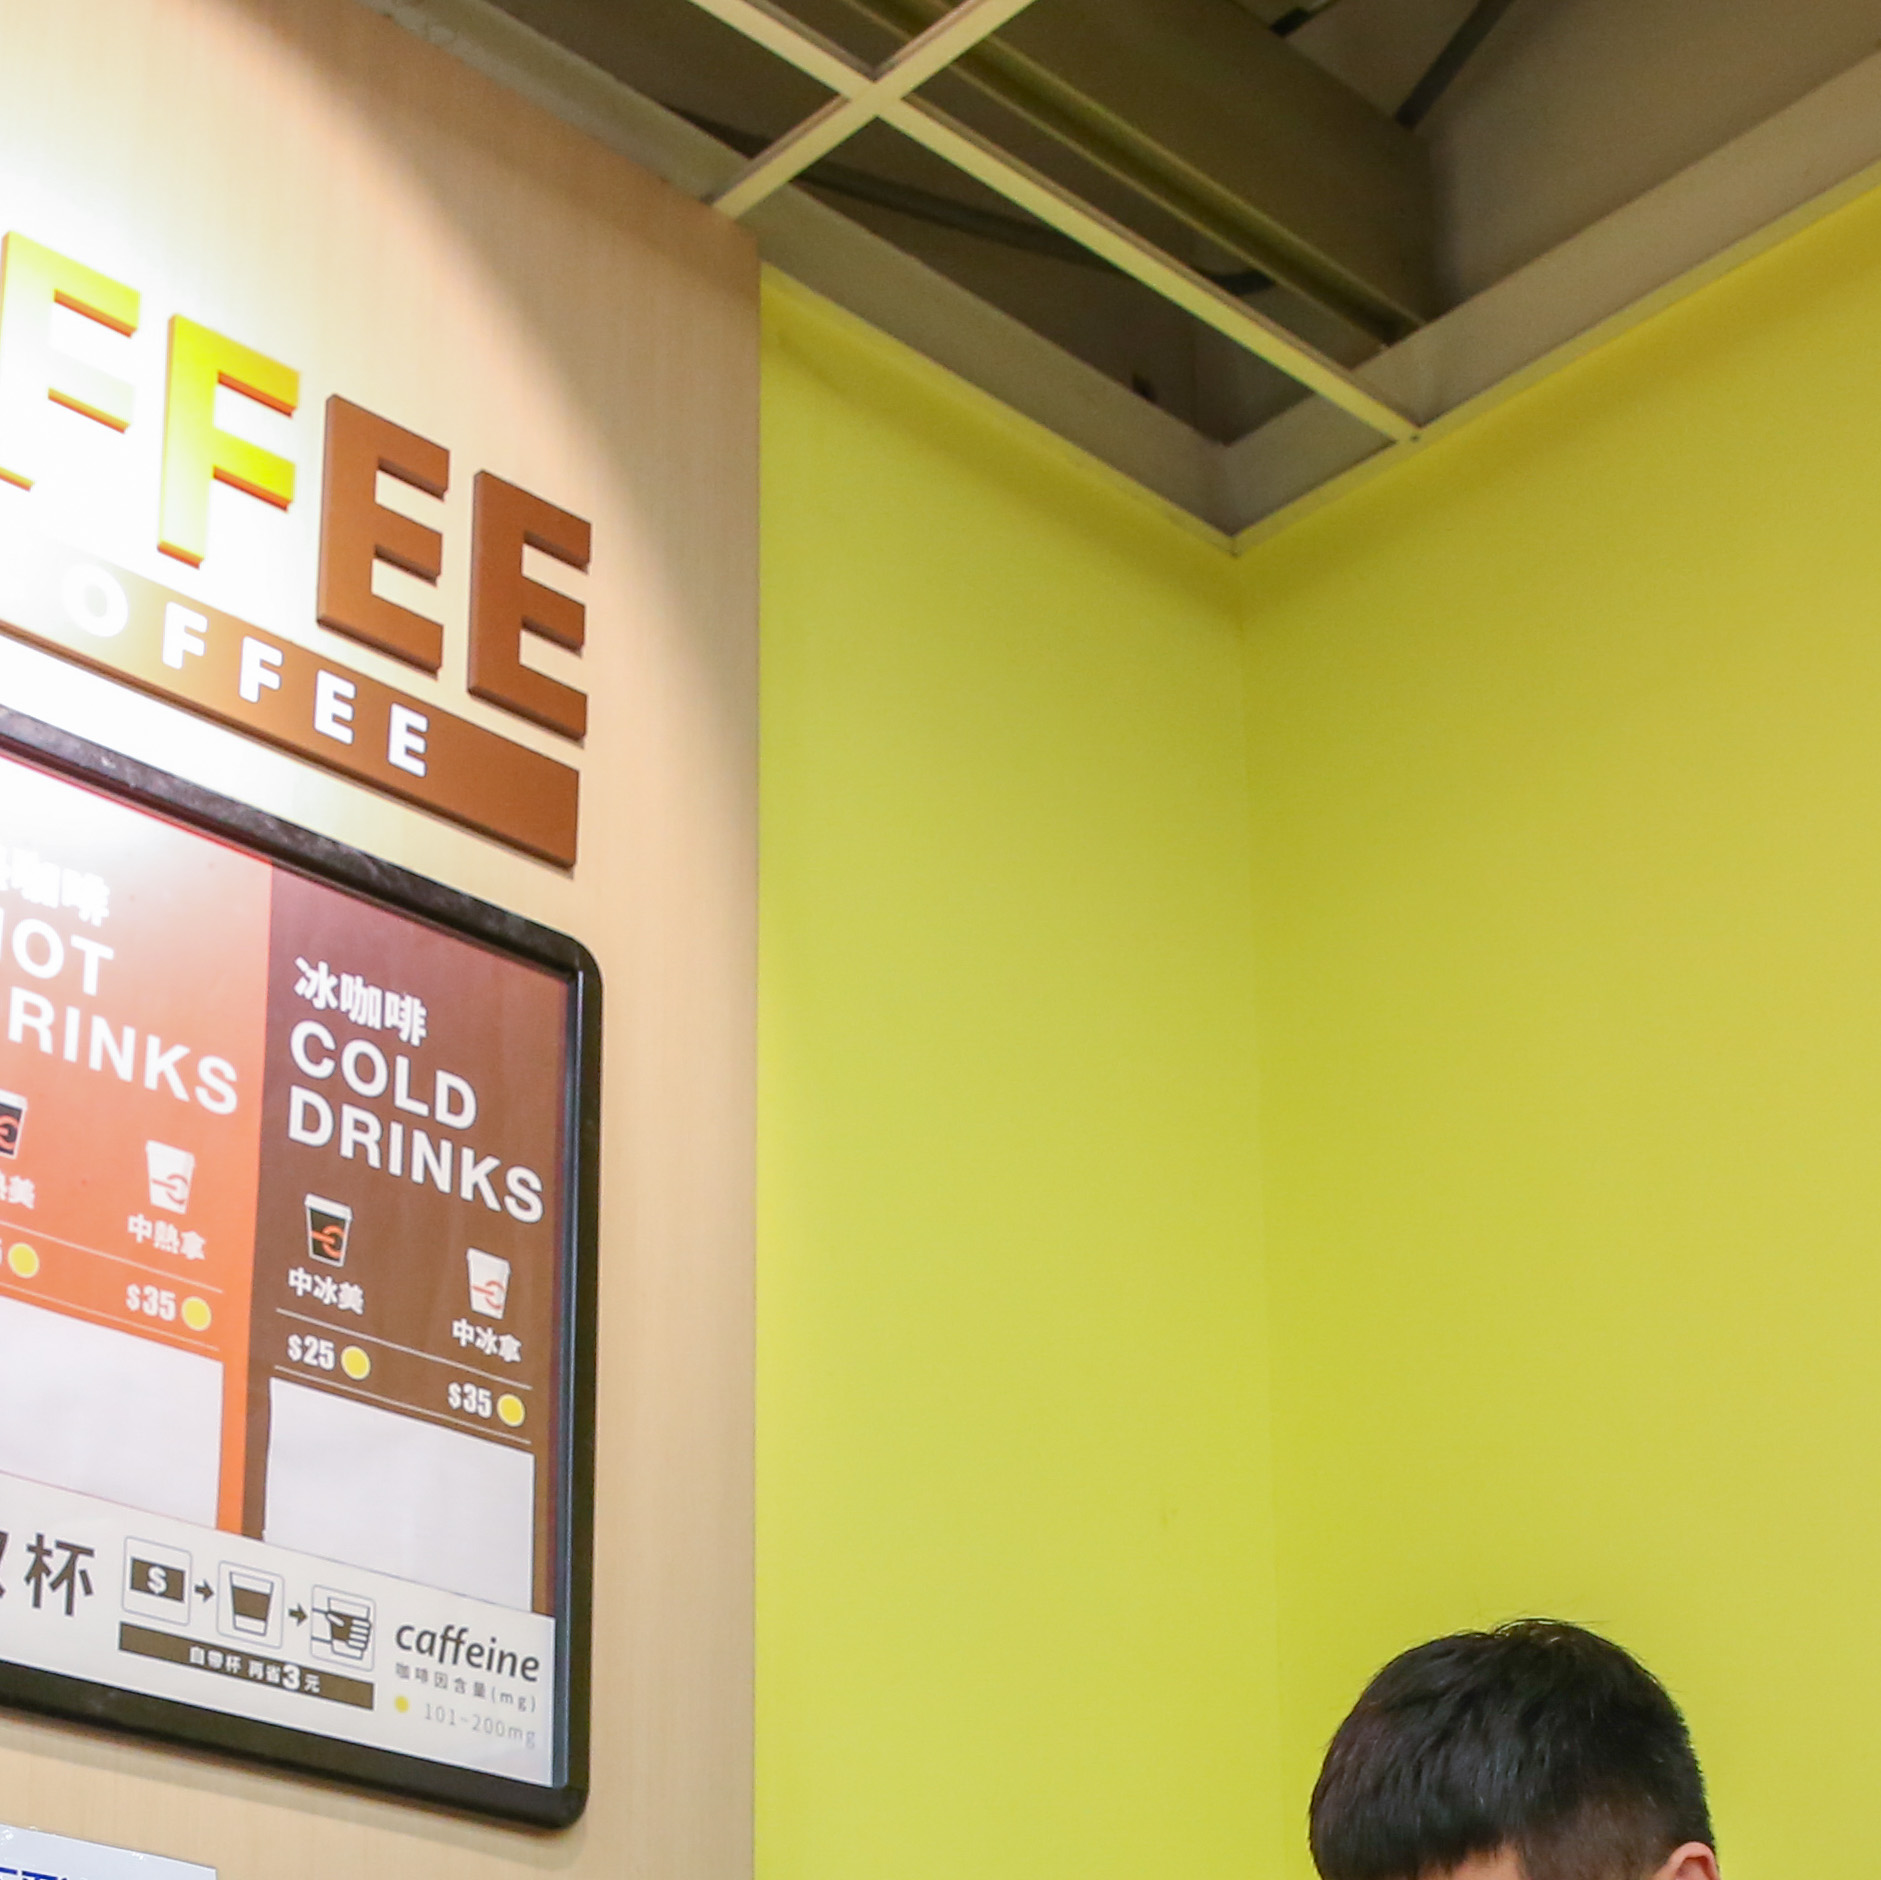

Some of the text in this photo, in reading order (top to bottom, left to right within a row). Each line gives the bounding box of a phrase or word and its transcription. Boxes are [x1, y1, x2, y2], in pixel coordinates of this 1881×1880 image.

[294, 956, 428, 1048] 冰咖啡
[289, 1019, 477, 1132] COLD
[288, 1084, 545, 1224] DRINKS
[126, 1284, 177, 1322] $35
[287, 1334, 337, 1371] $25
[447, 1382, 493, 1419] $35
[395, 1621, 540, 1683] caffeine
